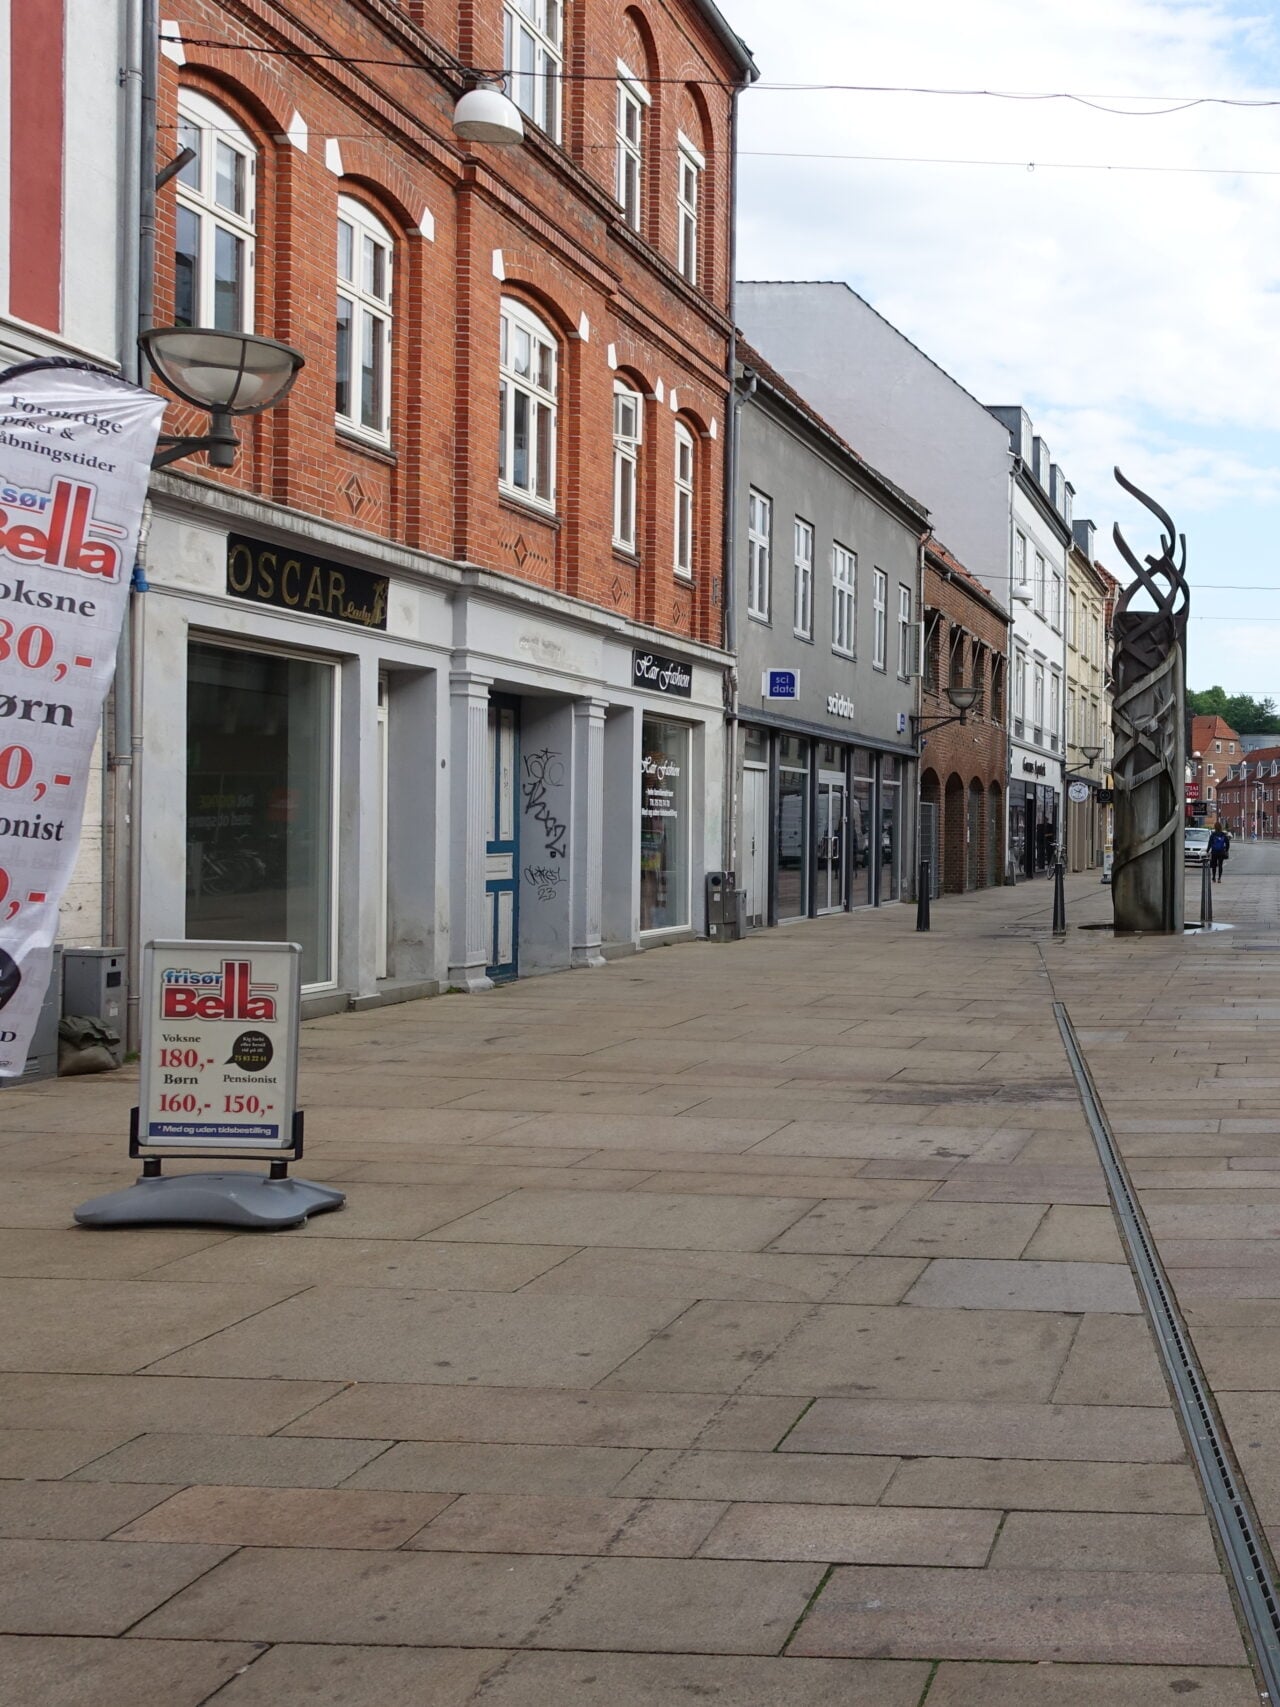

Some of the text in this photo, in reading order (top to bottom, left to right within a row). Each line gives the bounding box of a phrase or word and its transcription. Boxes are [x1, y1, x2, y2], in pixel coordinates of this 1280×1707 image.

[60, 427, 76, 441] &
[228, 543, 346, 616] OSCAR
[776, 676, 789, 684] sci
[772, 685, 795, 694] data
[165, 970, 223, 985] frisør
[164, 961, 274, 1020] Bella
[162, 1033, 201, 1043] Voksne
[158, 1048, 214, 1072] 180,-
[163, 1073, 199, 1085] Børn
[223, 1074, 278, 1084] Pensionist
[158, 1093, 211, 1117] 160,-
[223, 1094, 273, 1118] 150,-
[162, 1125, 272, 1135] Med og uden tidsbestilling
